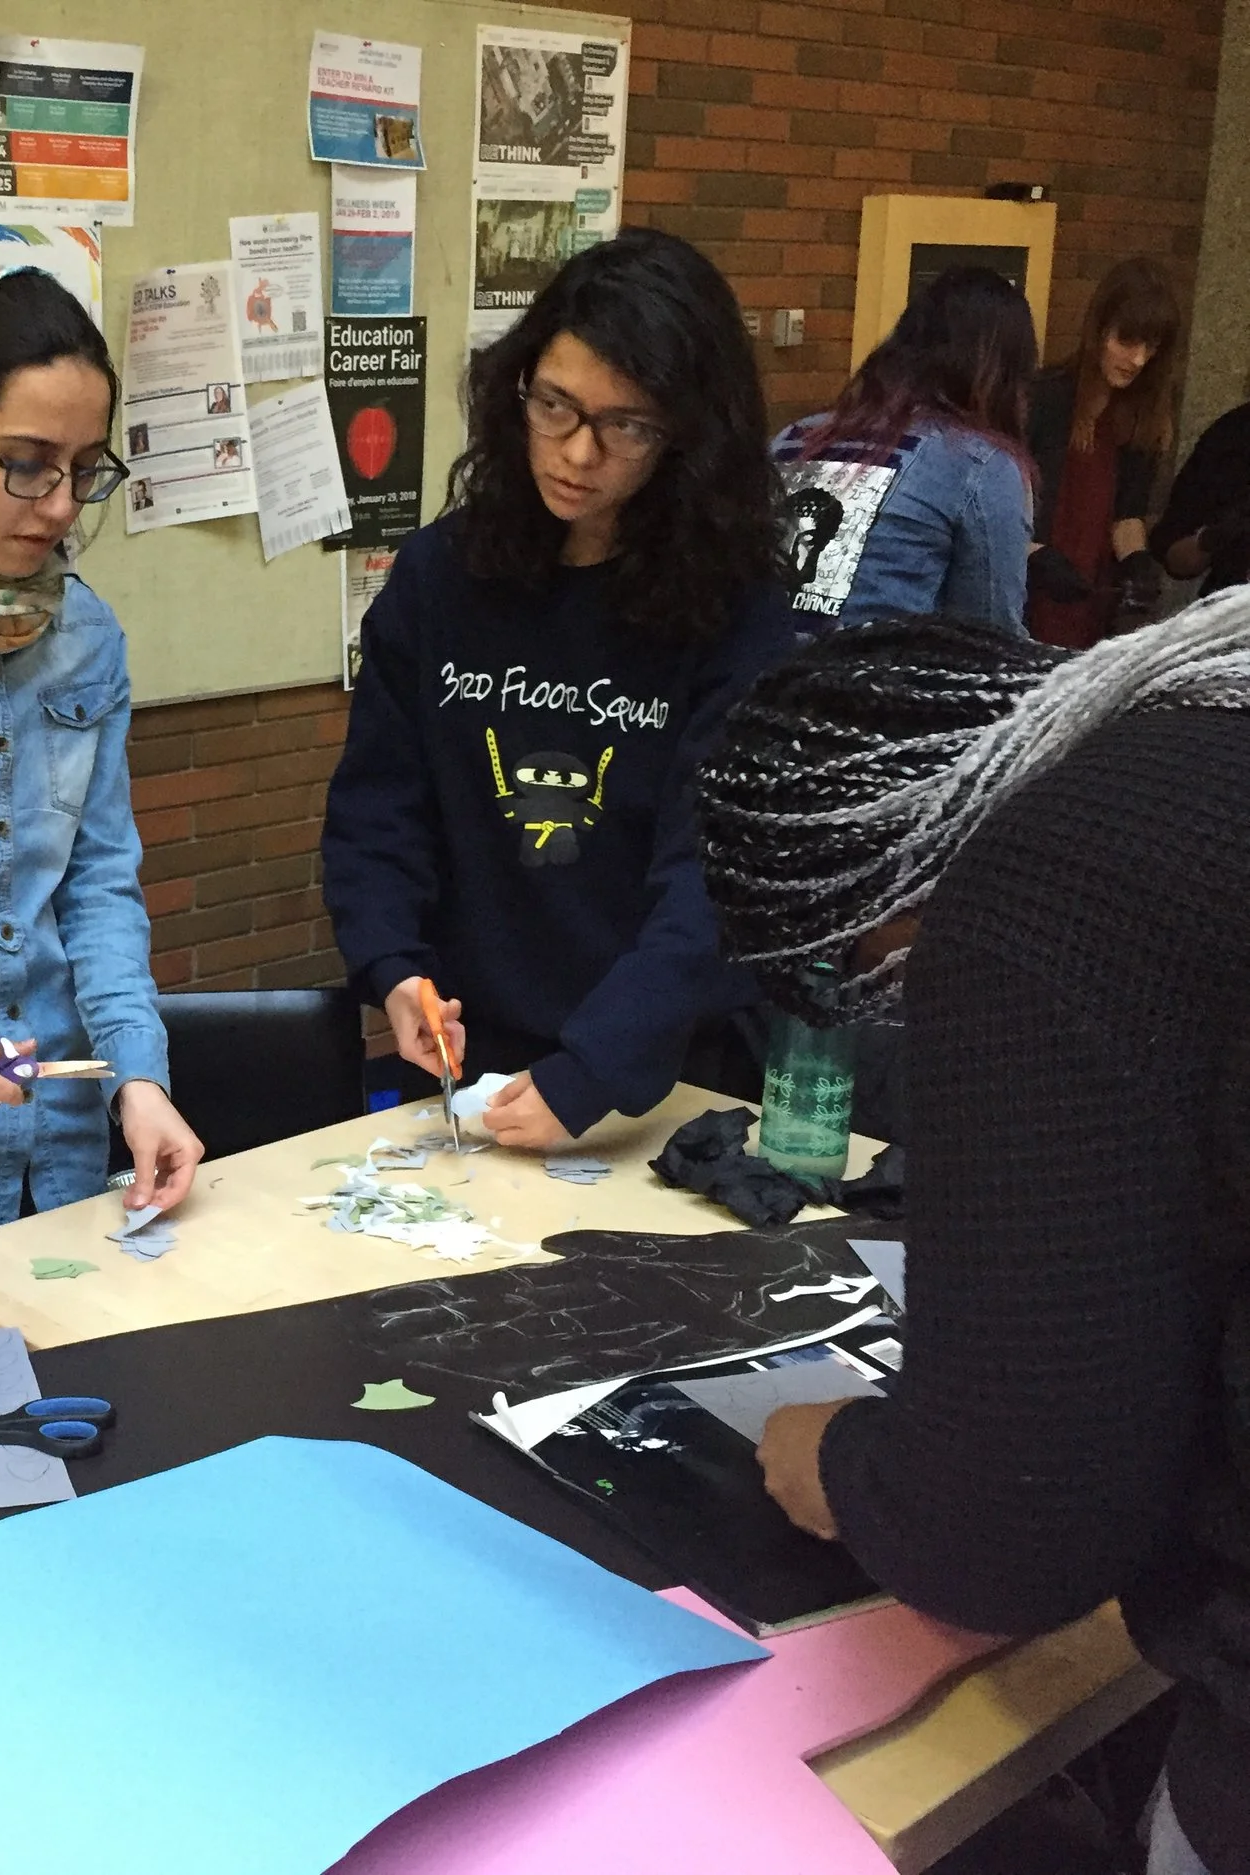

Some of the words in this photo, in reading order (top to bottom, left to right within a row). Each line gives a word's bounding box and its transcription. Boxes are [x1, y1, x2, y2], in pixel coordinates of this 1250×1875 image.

[372, 201, 396, 209] WEEK
[144, 285, 177, 301] TALKS
[330, 324, 414, 347] Education
[330, 350, 387, 372] Career
[391, 348, 422, 370] Fair
[357, 495, 386, 504] January
[400, 490, 417, 501] 2018
[792, 591, 845, 617] CHANCE
[438, 662, 493, 707] 3RD
